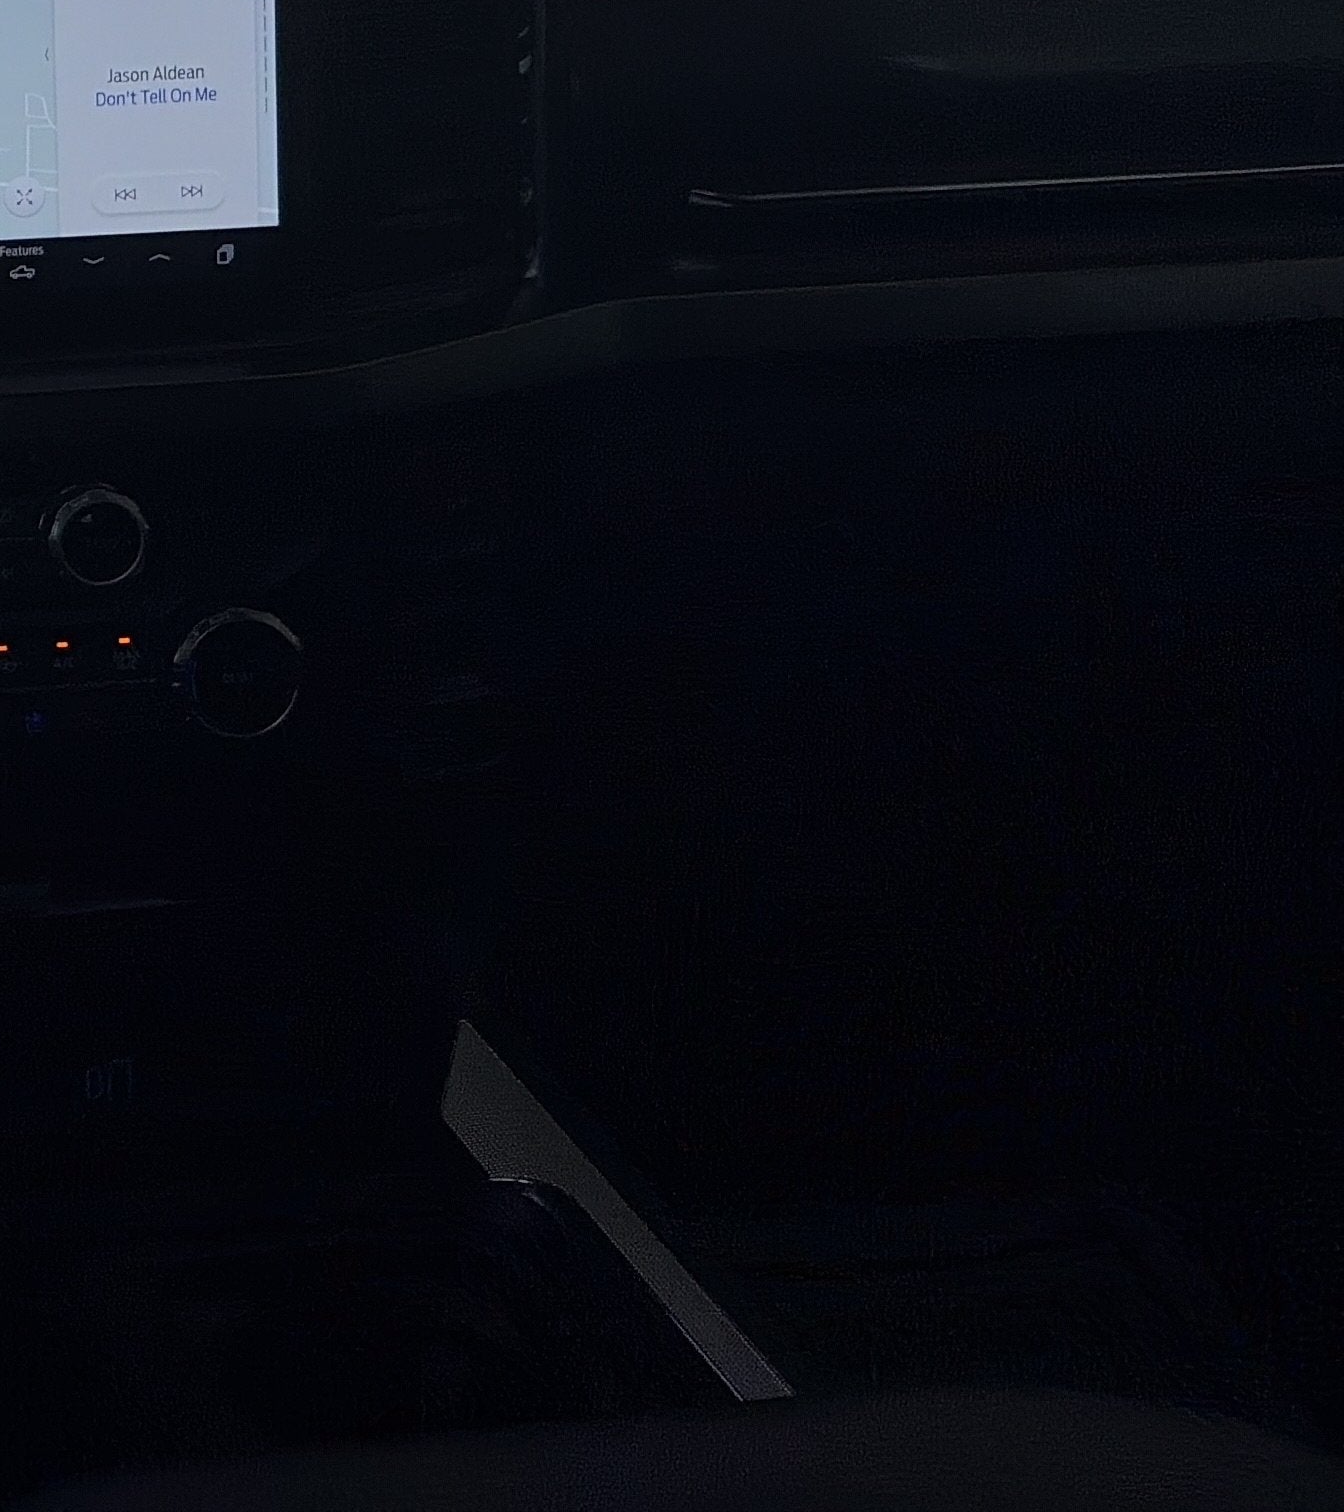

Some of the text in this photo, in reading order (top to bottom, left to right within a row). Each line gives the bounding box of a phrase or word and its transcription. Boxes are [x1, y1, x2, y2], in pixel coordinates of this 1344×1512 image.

[106, 65, 205, 85] Jason Aldean
[95, 87, 218, 108] Don't Tell On Me
[0, 244, 44, 258] Features
